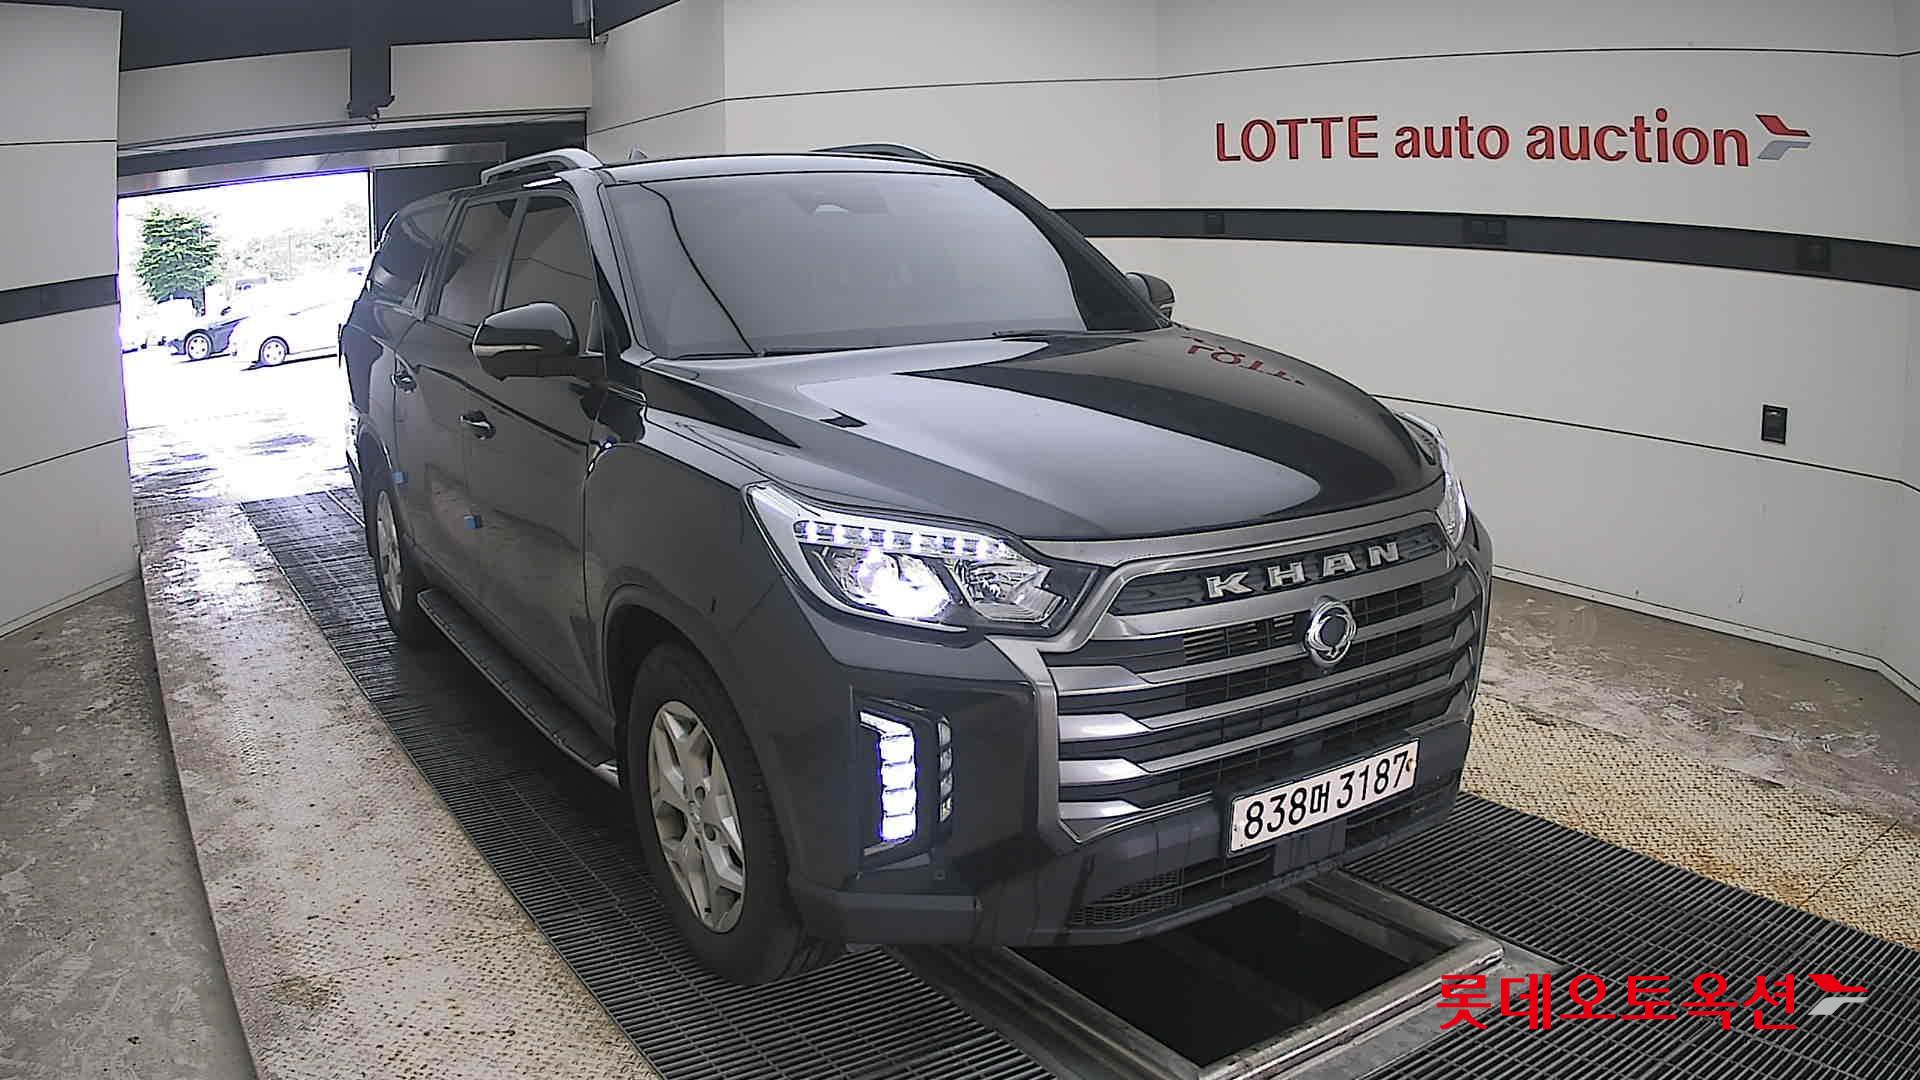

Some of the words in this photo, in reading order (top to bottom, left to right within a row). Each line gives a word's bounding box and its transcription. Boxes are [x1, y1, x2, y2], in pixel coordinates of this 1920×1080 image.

[1215, 115, 1378, 162] LOTTE
[1394, 115, 1510, 160] auto
[1526, 108, 1750, 167] auction
[1206, 541, 1400, 599] KHAN
[1243, 780, 1331, 840] 838머
[1336, 750, 1409, 809] 3187
